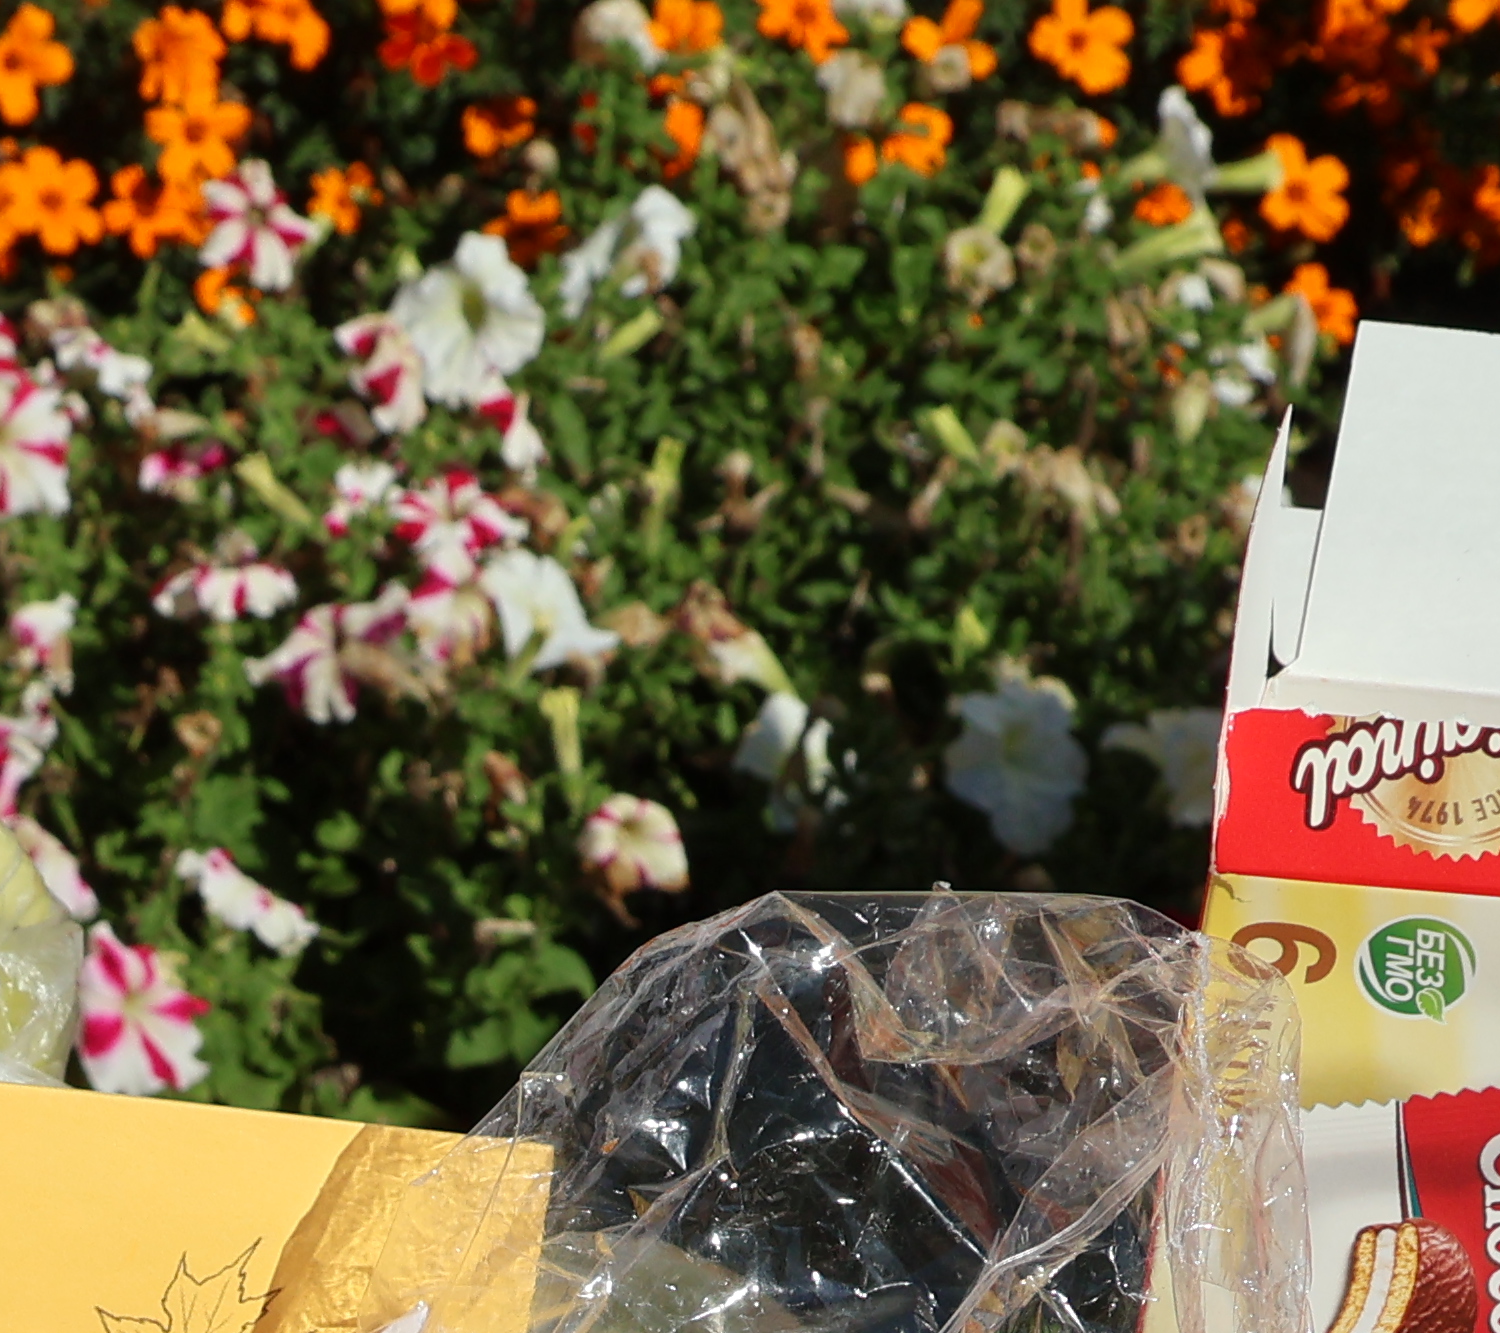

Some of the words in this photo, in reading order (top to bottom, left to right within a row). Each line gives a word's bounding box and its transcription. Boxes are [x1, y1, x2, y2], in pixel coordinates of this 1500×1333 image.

[1406, 795, 1464, 826] 1974
[1227, 921, 1338, 985] 6
[1384, 935, 1415, 1002] ГМО
[1415, 928, 1445, 991] БЕЗ
